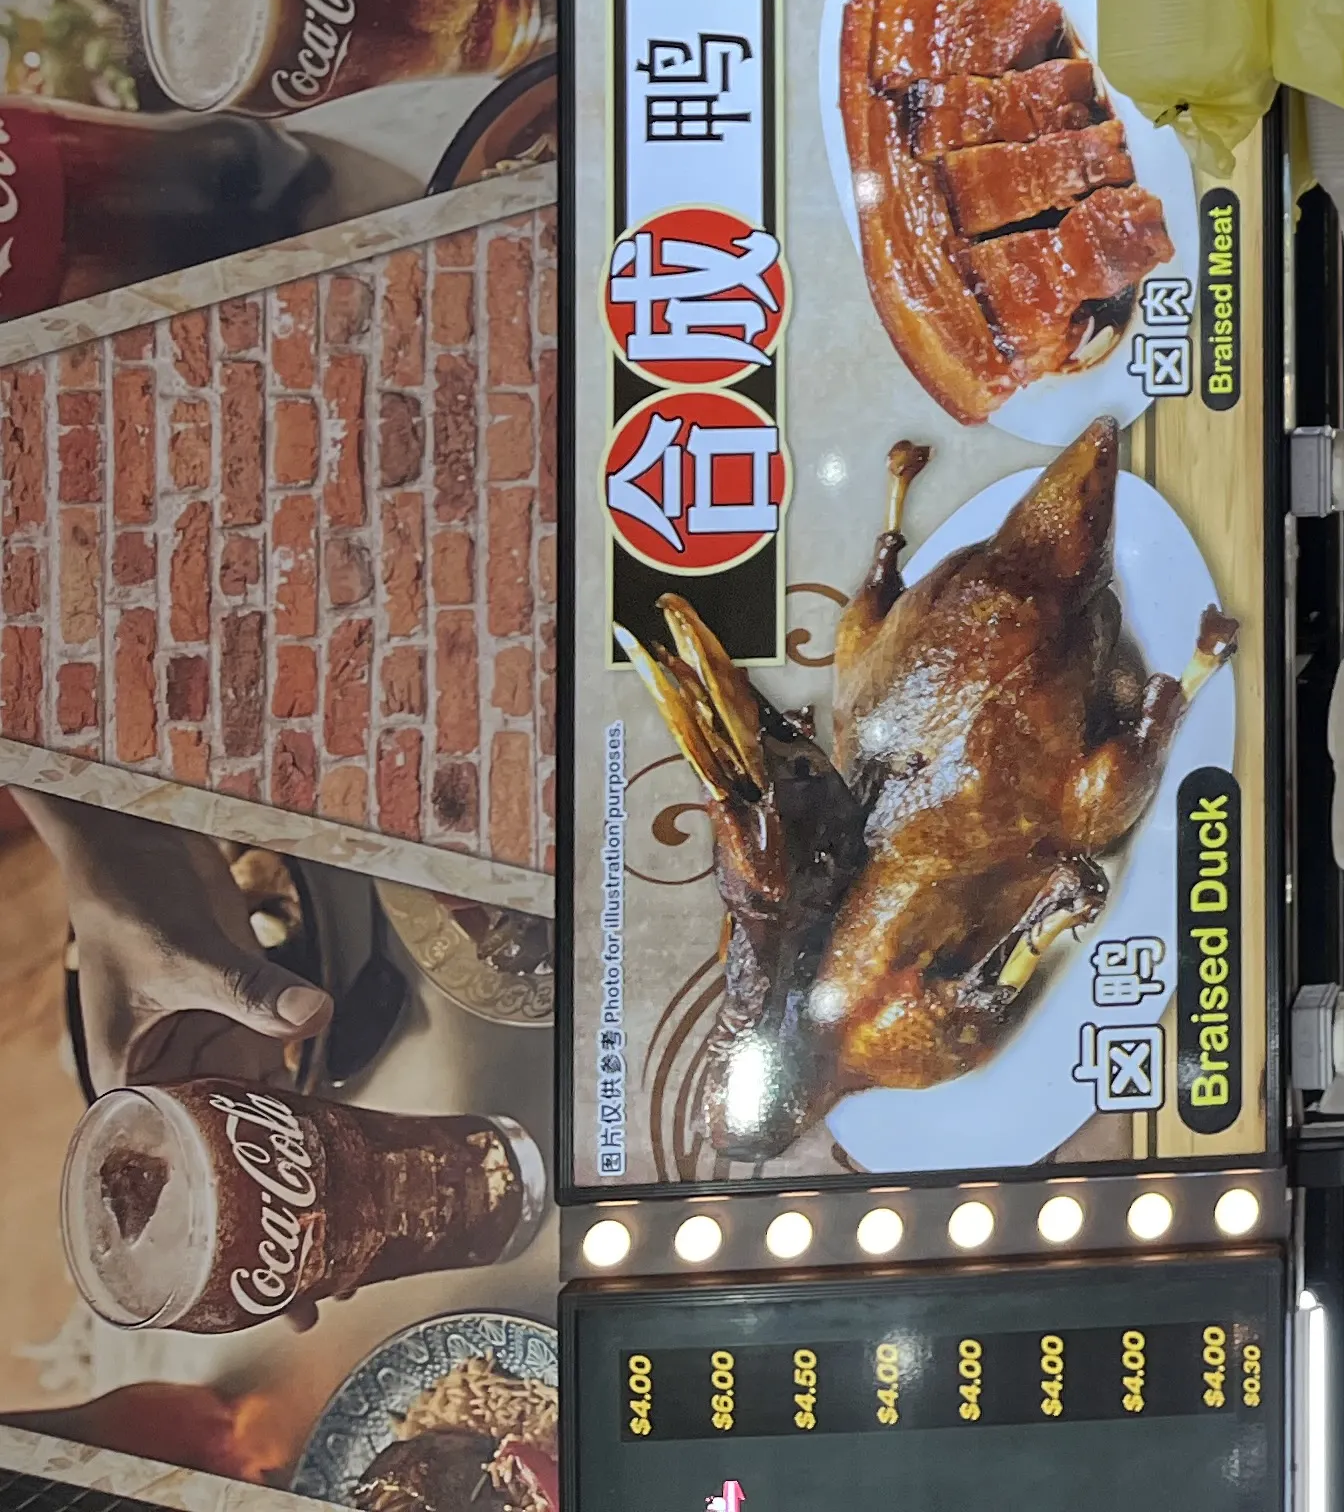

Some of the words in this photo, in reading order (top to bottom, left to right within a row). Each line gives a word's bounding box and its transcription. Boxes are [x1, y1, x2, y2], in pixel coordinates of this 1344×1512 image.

[1207, 205, 1235, 276] Meat
[1130, 277, 1194, 398] 卤肉
[1207, 284, 1235, 395] Braised
[606, 722, 626, 818] purposes.
[605, 825, 621, 929] illustration
[1189, 794, 1230, 914] Duck
[605, 935, 620, 962] for
[604, 967, 619, 1023] Photo
[1073, 934, 1166, 1113] 卤鸭
[1189, 927, 1230, 1107] Braised
[600, 1030, 622, 1174] 图片仅供参考
[209, 1093, 316, 1314] Coca-Cola
[628, 1354, 651, 1435] $4.00
[711, 1351, 734, 1430] $6.00
[794, 1349, 817, 1429] $4.50
[876, 1343, 899, 1425] $4.00
[958, 1339, 982, 1421] $4.00
[1040, 1335, 1064, 1416] $4.00
[1121, 1330, 1145, 1412] $4.00
[1202, 1326, 1226, 1408] $4.00
[1242, 1344, 1261, 1407] $0.30
